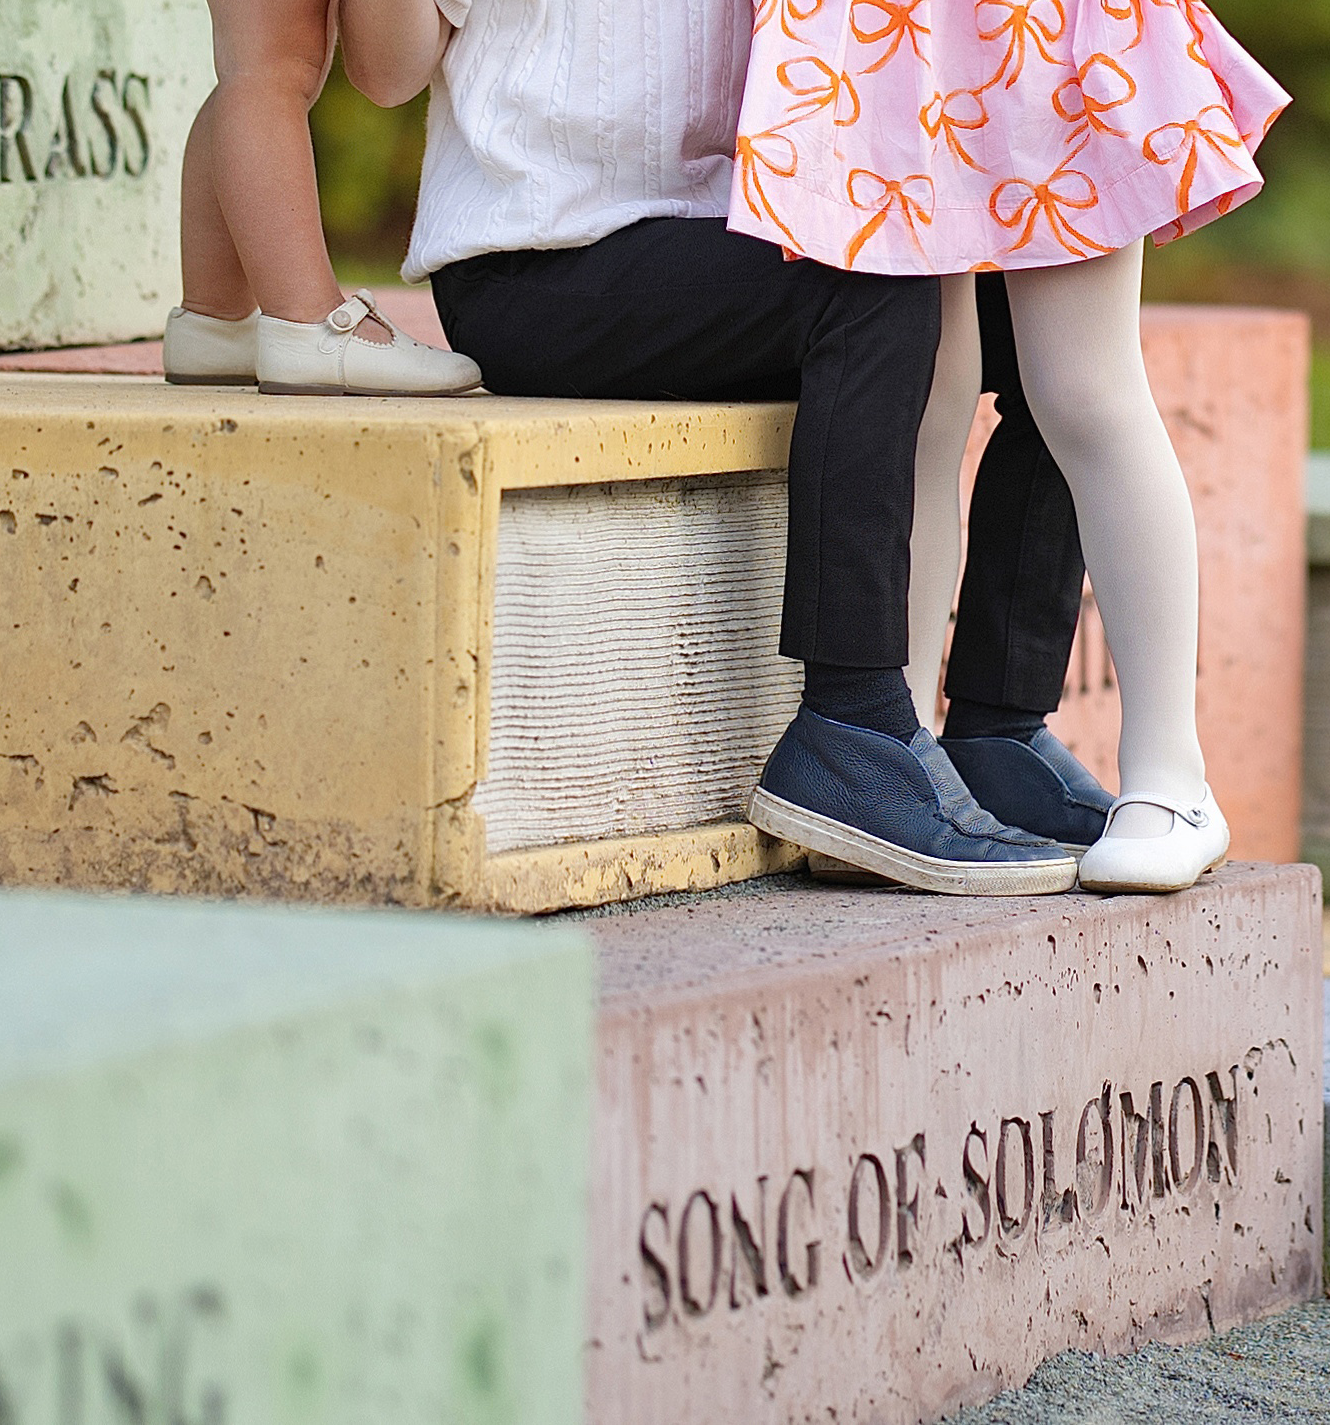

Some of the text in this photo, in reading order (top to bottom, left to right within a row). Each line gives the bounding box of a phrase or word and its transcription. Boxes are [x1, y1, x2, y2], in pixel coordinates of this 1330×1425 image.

[638, 1062, 1242, 1331] SONG OF SOLOMON
